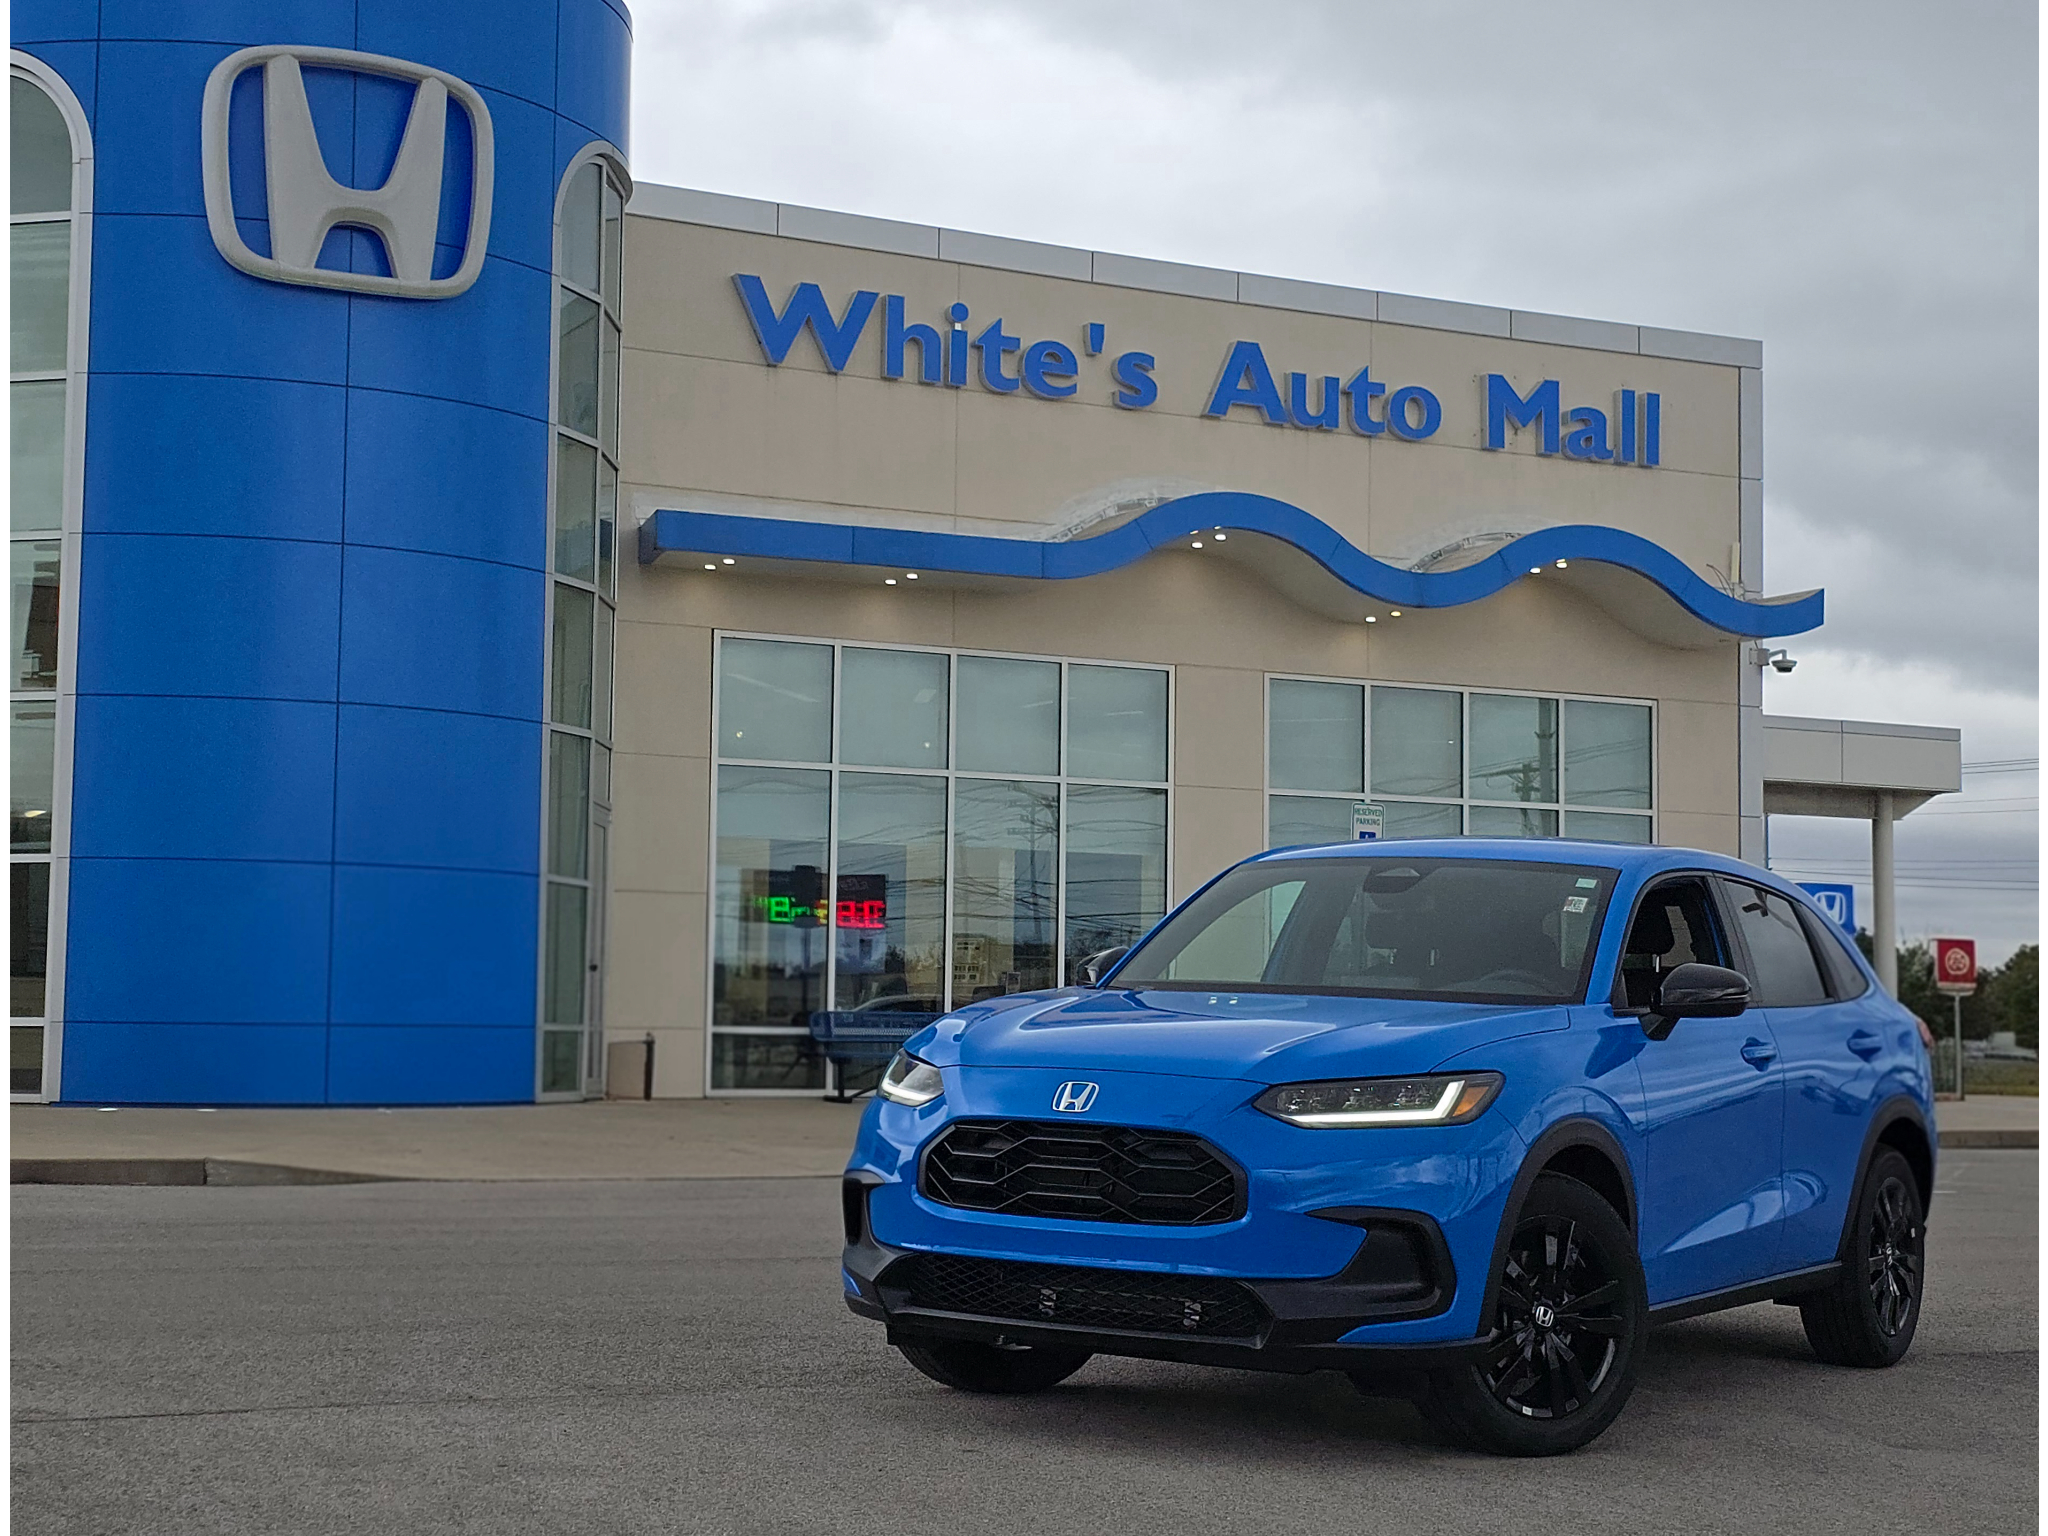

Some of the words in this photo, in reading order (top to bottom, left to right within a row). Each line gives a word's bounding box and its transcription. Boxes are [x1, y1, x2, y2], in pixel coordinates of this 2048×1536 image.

[731, 273, 1159, 410] White's
[1203, 340, 1442, 442] Auto
[1480, 373, 1661, 467] Mall
